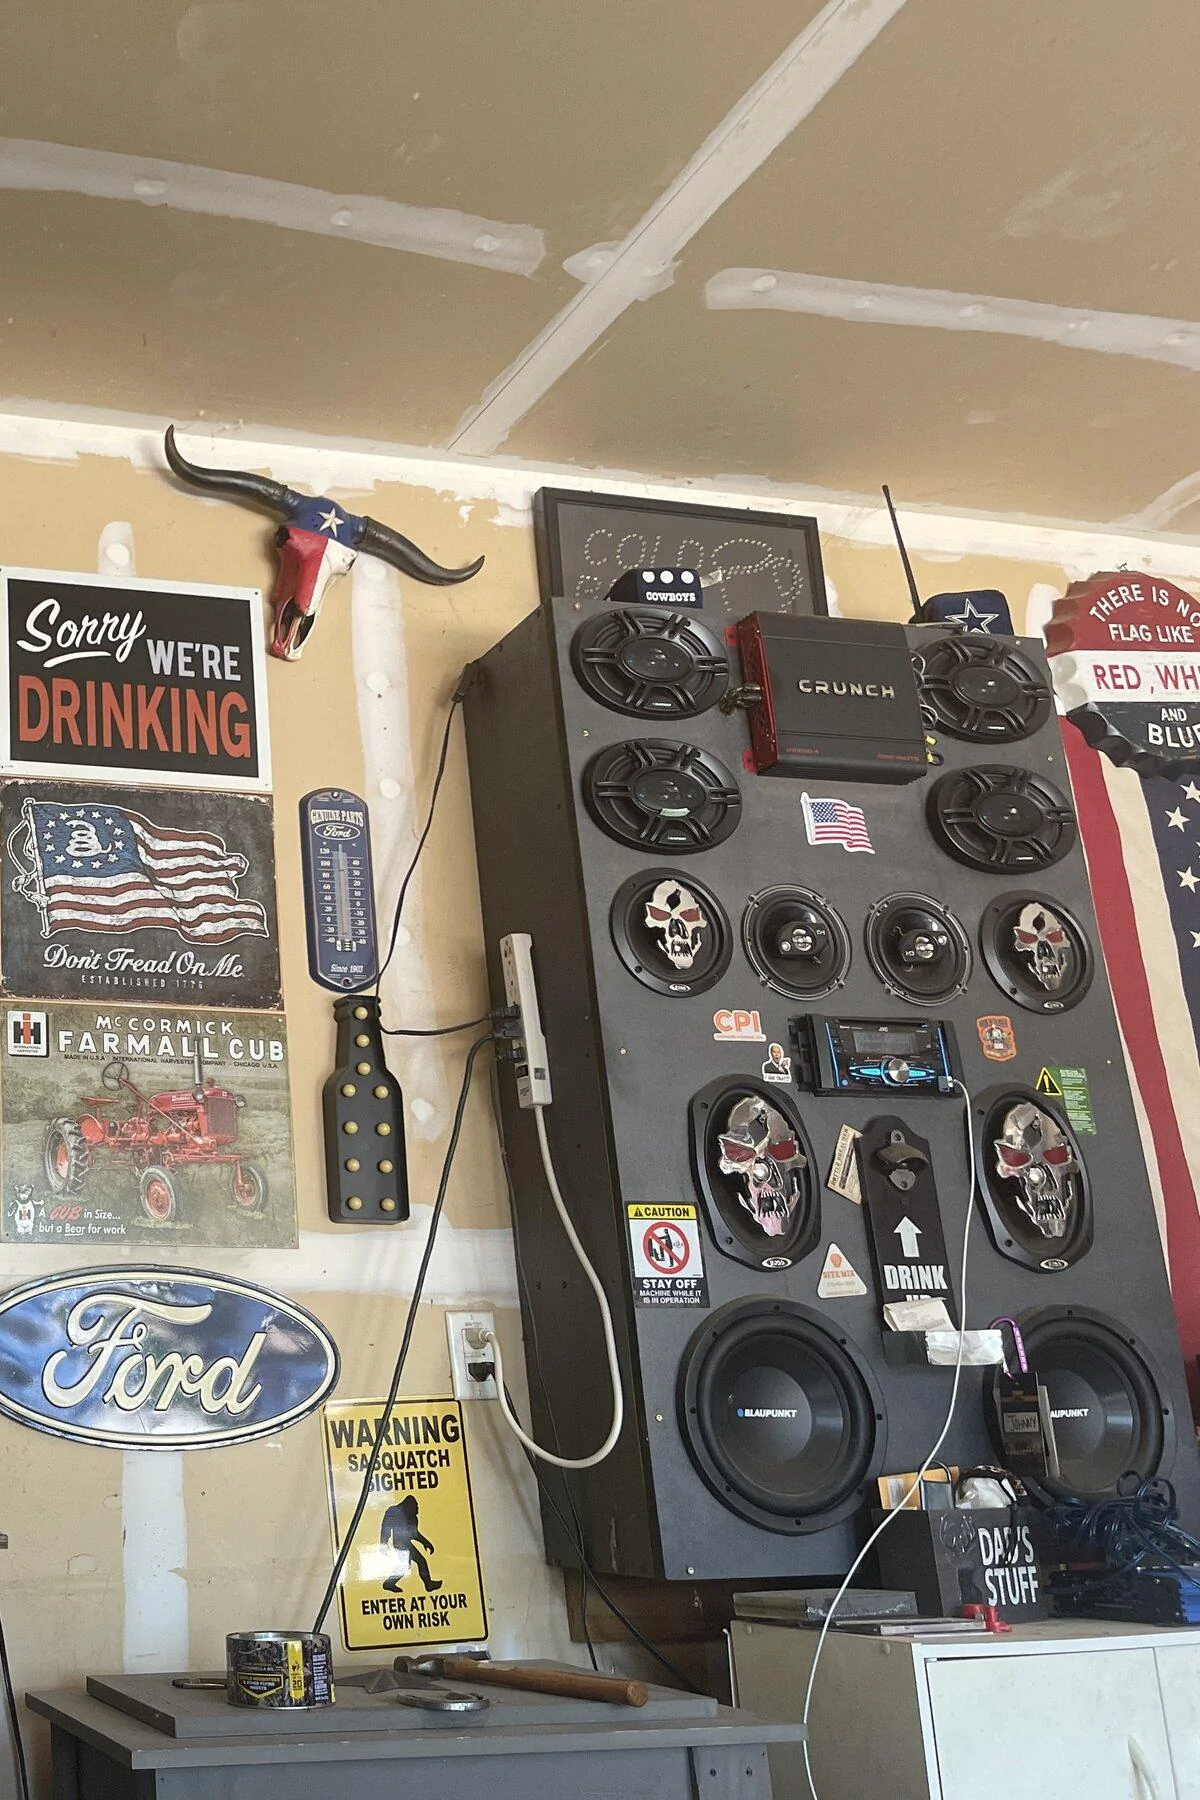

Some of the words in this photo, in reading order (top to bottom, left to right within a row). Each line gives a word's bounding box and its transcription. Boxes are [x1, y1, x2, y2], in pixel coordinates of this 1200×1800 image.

[646, 591, 696, 602] COWBOYS
[1089, 584, 1145, 623] THERE
[1151, 585, 1169, 606] IS
[1176, 599, 1200, 628] NO
[16, 598, 147, 663] Sorry
[1108, 623, 1152, 642] FLAG
[1156, 625, 1194, 644] LIKE
[147, 638, 241, 681] WE'RE
[1093, 664, 1142, 690] RED
[798, 679, 895, 699] CRUNCH
[18, 675, 251, 758] DRINKING
[1161, 708, 1187, 722] AND
[310, 809, 340, 825] GENUINE
[340, 810, 364, 828] PARTS
[323, 824, 352, 838] Ford
[43, 943, 102, 970] Don't
[104, 948, 176, 972] Tread
[176, 951, 207, 976] On
[206, 953, 245, 978] Me
[330, 964, 348, 972] Since
[350, 965, 364, 973] 1903
[81, 975, 166, 988] ESTABLISHED
[176, 979, 203, 989] 1776
[715, 1011, 759, 1033] CPI
[58, 1030, 219, 1059] FARMALL
[229, 1037, 284, 1062] CUB
[112, 1056, 158, 1064] INTERNATIONAL
[39, 1209, 46, 1218] A
[50, 1205, 81, 1221] CUB
[84, 1210, 92, 1219] in
[644, 1207, 690, 1217] CAUTION
[38, 1223, 55, 1234] but
[56, 1225, 62, 1233] a
[65, 1224, 85, 1235] Bear
[87, 1225, 100, 1234] for
[103, 1225, 126, 1235] work
[643, 1279, 673, 1289] STAY
[675, 1279, 697, 1289] OFF
[883, 1265, 948, 1290] DRINK
[41, 1291, 268, 1415] Ford
[744, 1408, 798, 1418] BLAUPUNKT
[330, 1414, 460, 1449] WARNING
[347, 1449, 451, 1472] SASQUATCH
[367, 1470, 439, 1493] SIGHTED
[985, 1566, 1039, 1607] STUFF
[361, 1597, 406, 1616] ENTER
[409, 1596, 426, 1612] AT
[431, 1593, 468, 1610] YOUR
[382, 1614, 414, 1631] OWN
[418, 1611, 450, 1629] RISK
[292, 1680, 302, 1688] 20
